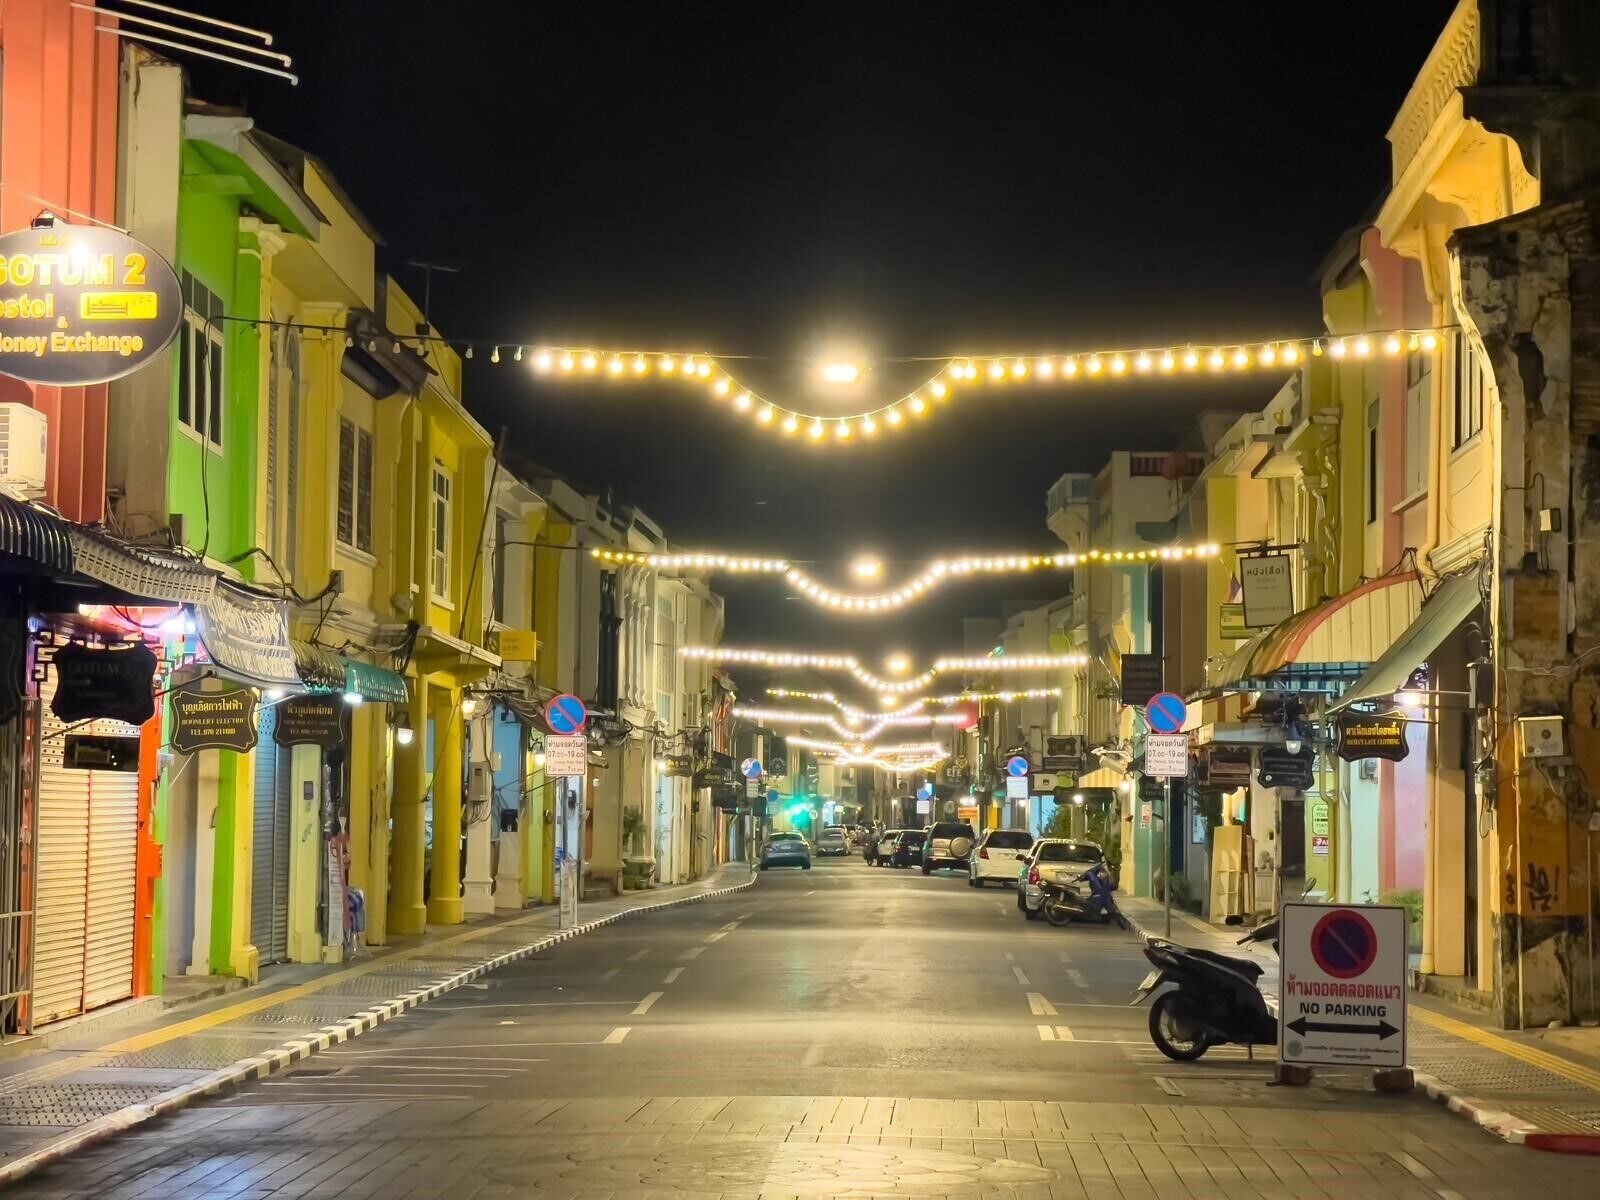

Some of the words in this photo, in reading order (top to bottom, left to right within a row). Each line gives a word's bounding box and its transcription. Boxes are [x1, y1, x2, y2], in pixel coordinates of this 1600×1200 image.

[123, 253, 147, 286] 2
[57, 316, 69, 329] &
[0, 333, 48, 357] oney
[51, 331, 144, 356] Exchange
[1287, 974, 1400, 1000] ห้ามจอดตลอดแนว
[1300, 1002, 1320, 1014] NO
[1325, 1004, 1387, 1017] PARKING
